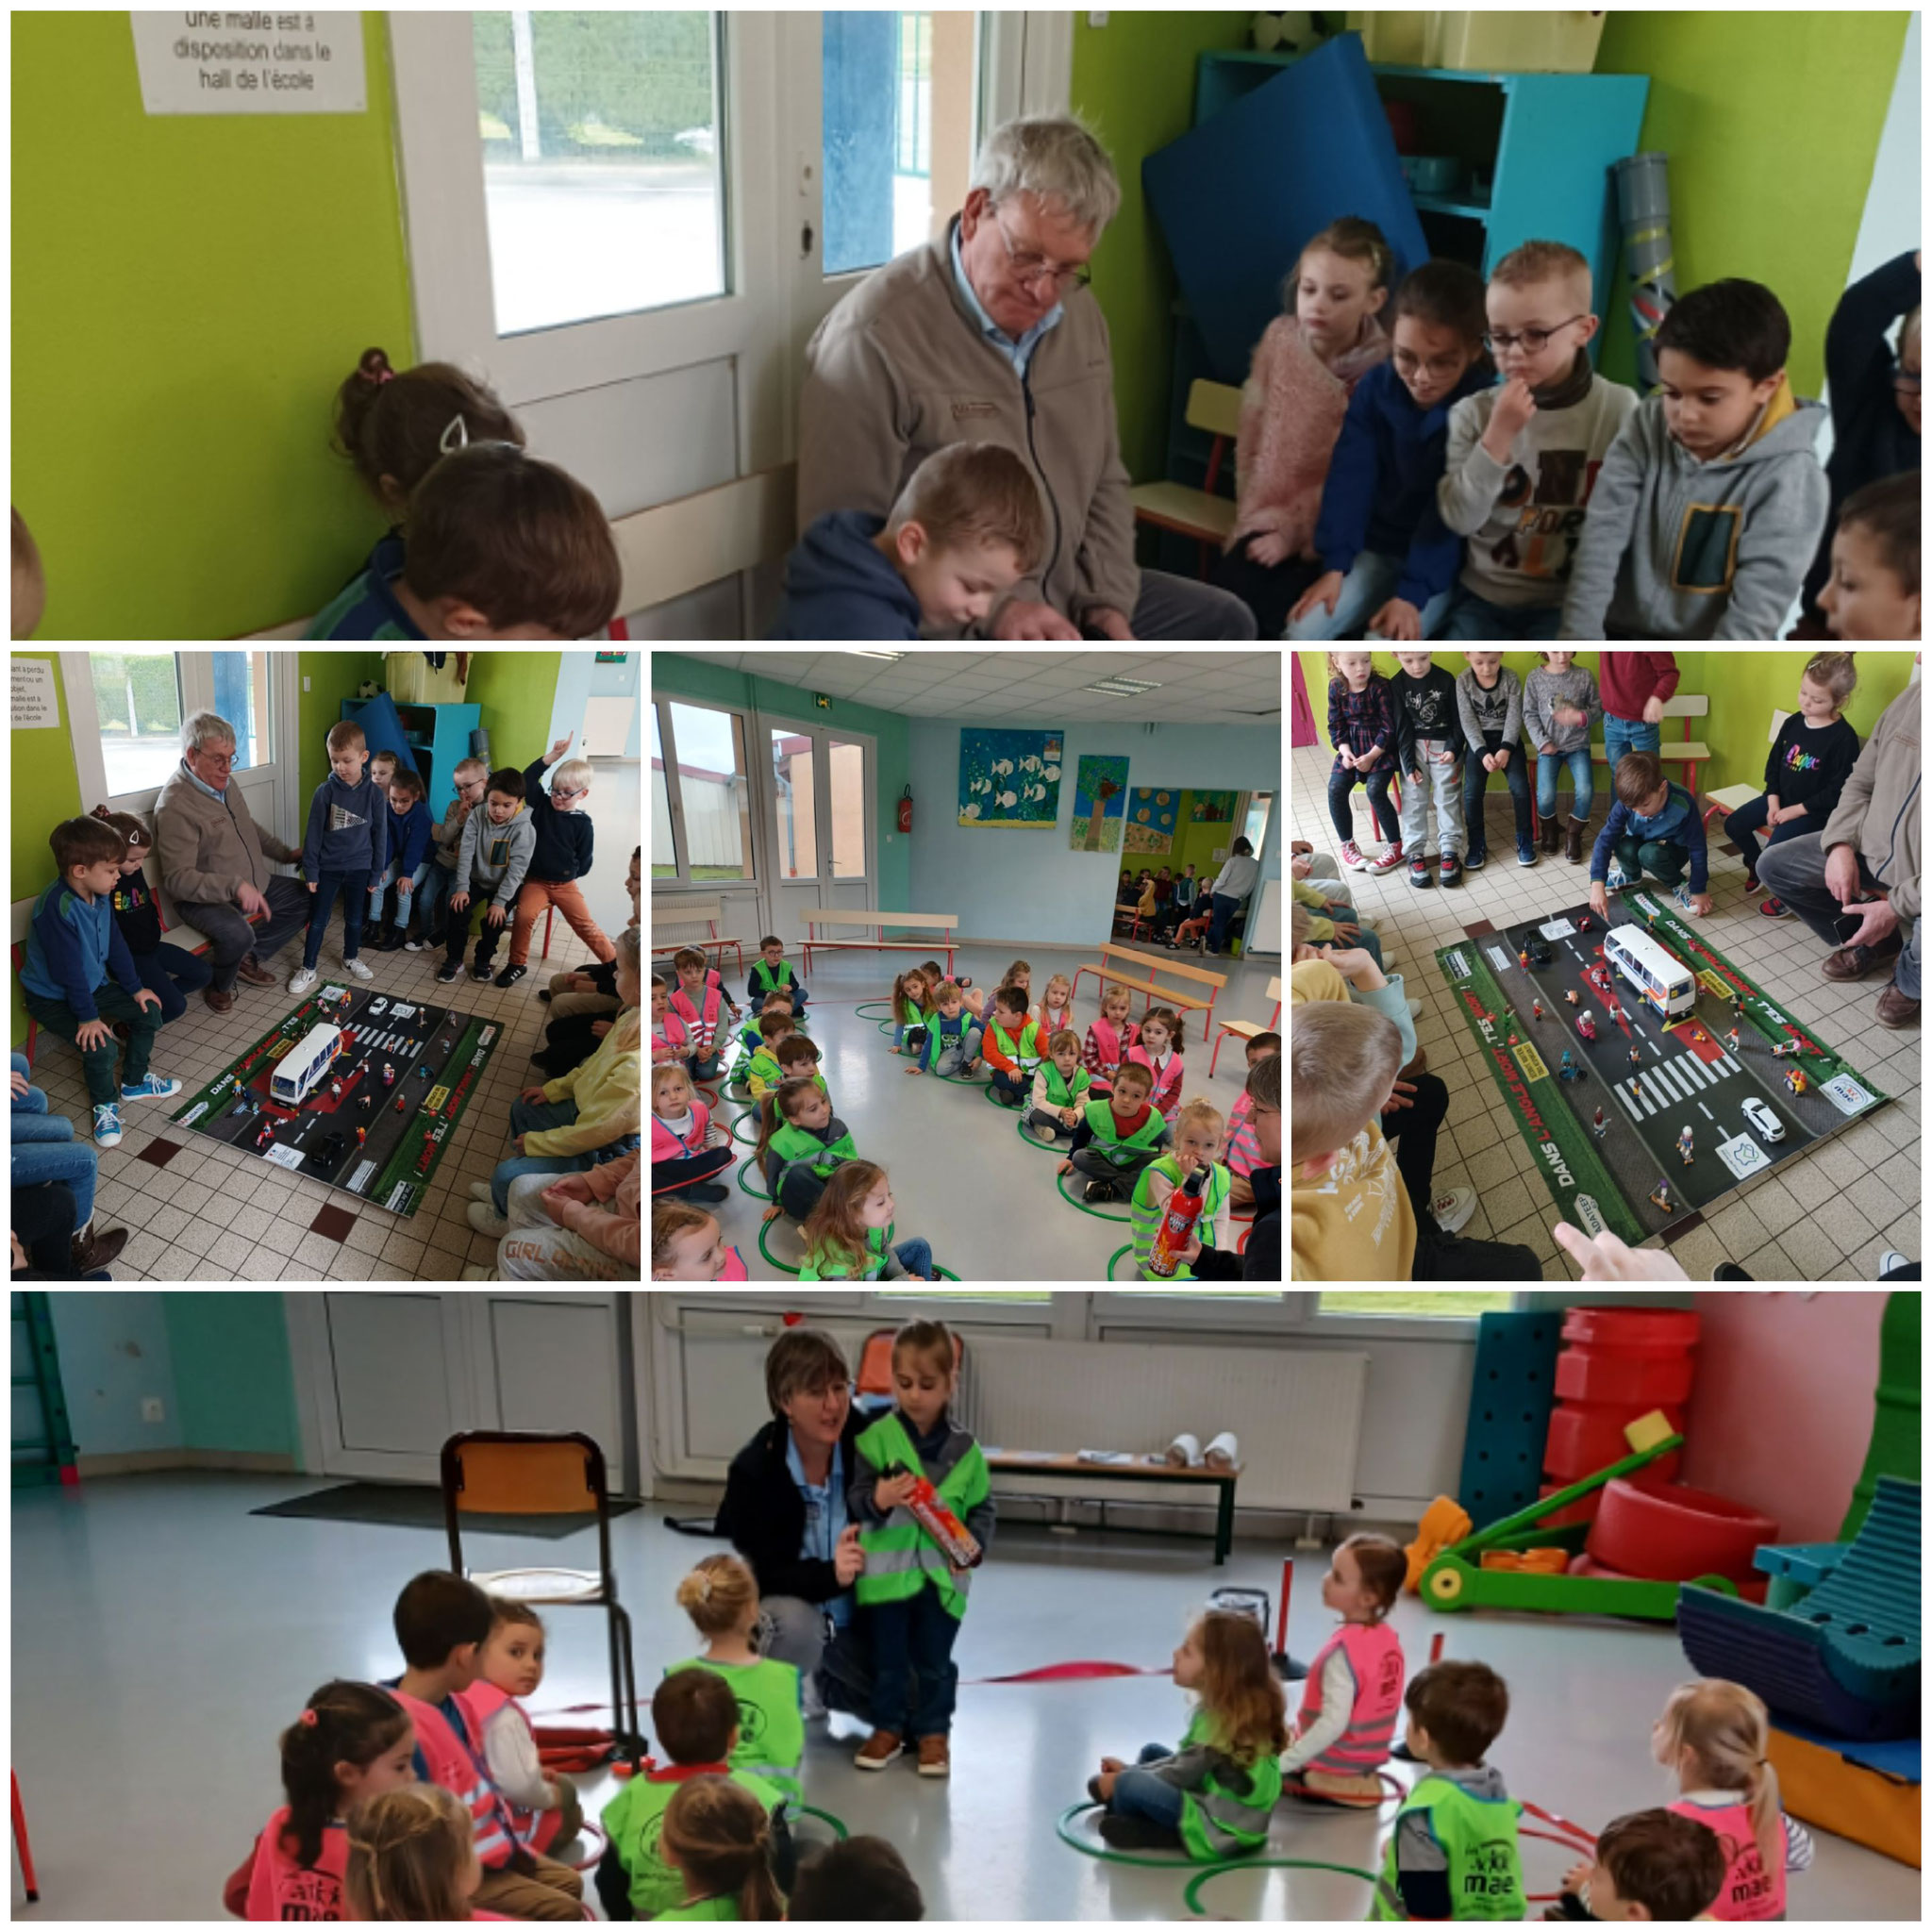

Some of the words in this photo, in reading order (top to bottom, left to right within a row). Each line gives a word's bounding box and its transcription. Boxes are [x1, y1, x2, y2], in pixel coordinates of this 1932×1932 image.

[225, 11, 272, 30] malle
[277, 13, 301, 31] est
[174, 36, 269, 61] disposition
[273, 40, 314, 61] dans
[315, 41, 331, 61] le
[198, 68, 232, 90] hall
[236, 69, 258, 91] de
[1665, 920, 1692, 941] DANS
[1462, 990, 1487, 1019] MORT
[209, 1074, 236, 1095] DANS
[1833, 1085, 1855, 1104] mae
[1541, 1141, 1575, 1188] DANS
[505, 1240, 546, 1264] GIRL
[1464, 1874, 1515, 1895] mae
[1732, 1875, 1772, 1905] mae
